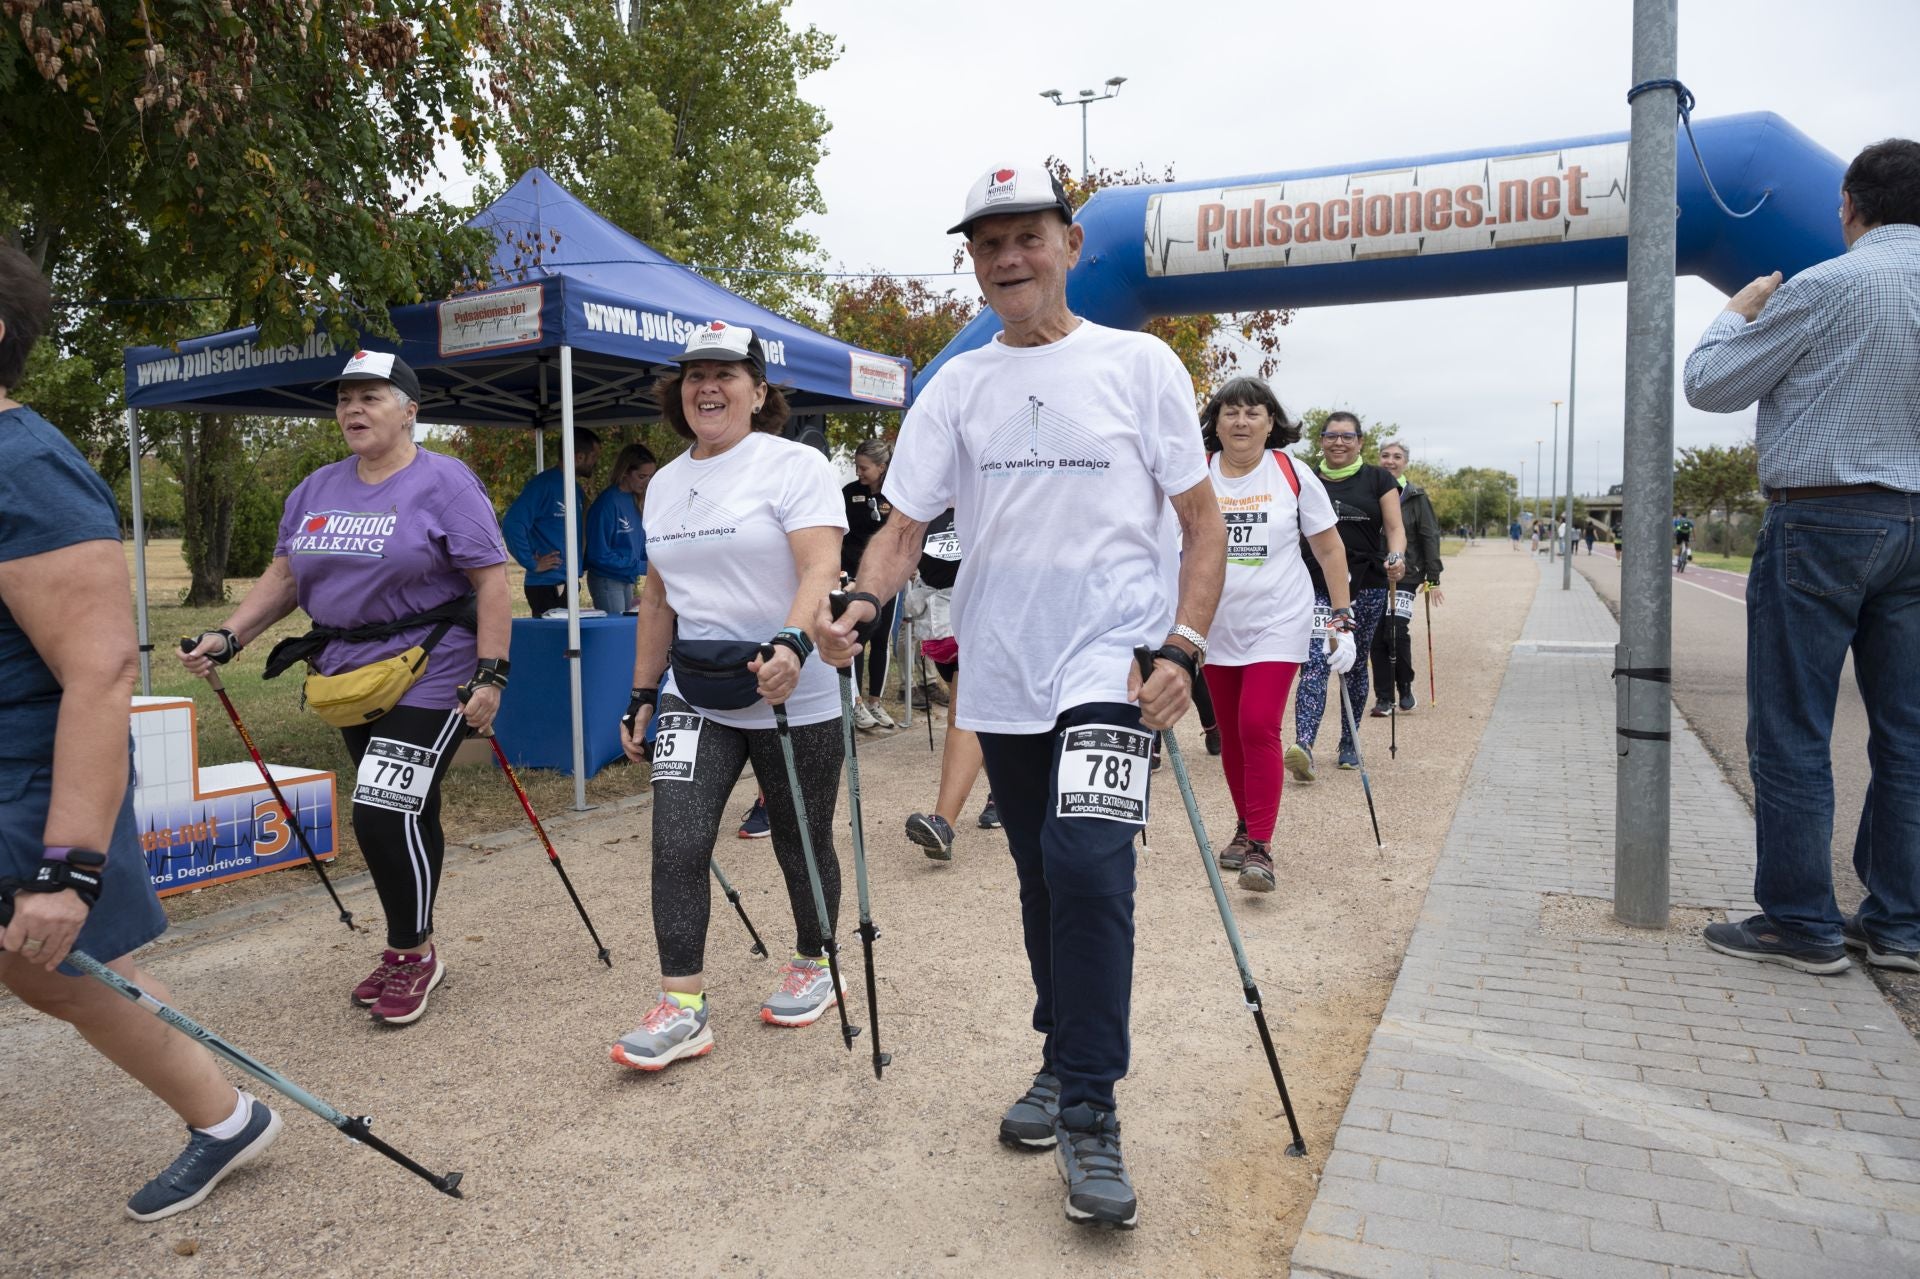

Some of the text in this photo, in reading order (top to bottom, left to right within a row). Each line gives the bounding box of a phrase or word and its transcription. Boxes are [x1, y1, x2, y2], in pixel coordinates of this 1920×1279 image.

[1197, 165, 1589, 252] Pulsaciones.net
[453, 302, 526, 324] Pulsaciones.net
[1005, 459, 1055, 469] Walking
[1059, 459, 1111, 470] Badajoz
[323, 515, 397, 537] NORDIC
[662, 531, 696, 541] Walking
[699, 527, 737, 536] Badajoz
[292, 536, 385, 553] WALKING
[374, 759, 414, 790] 779
[1086, 754, 1132, 792] 783
[381, 790, 419, 806] EXTREMADURA
[1065, 793, 1140, 812] JUNTA DE EXTREMADURA
[254, 798, 292, 857] 3
[178, 855, 252, 879] Deportivos
